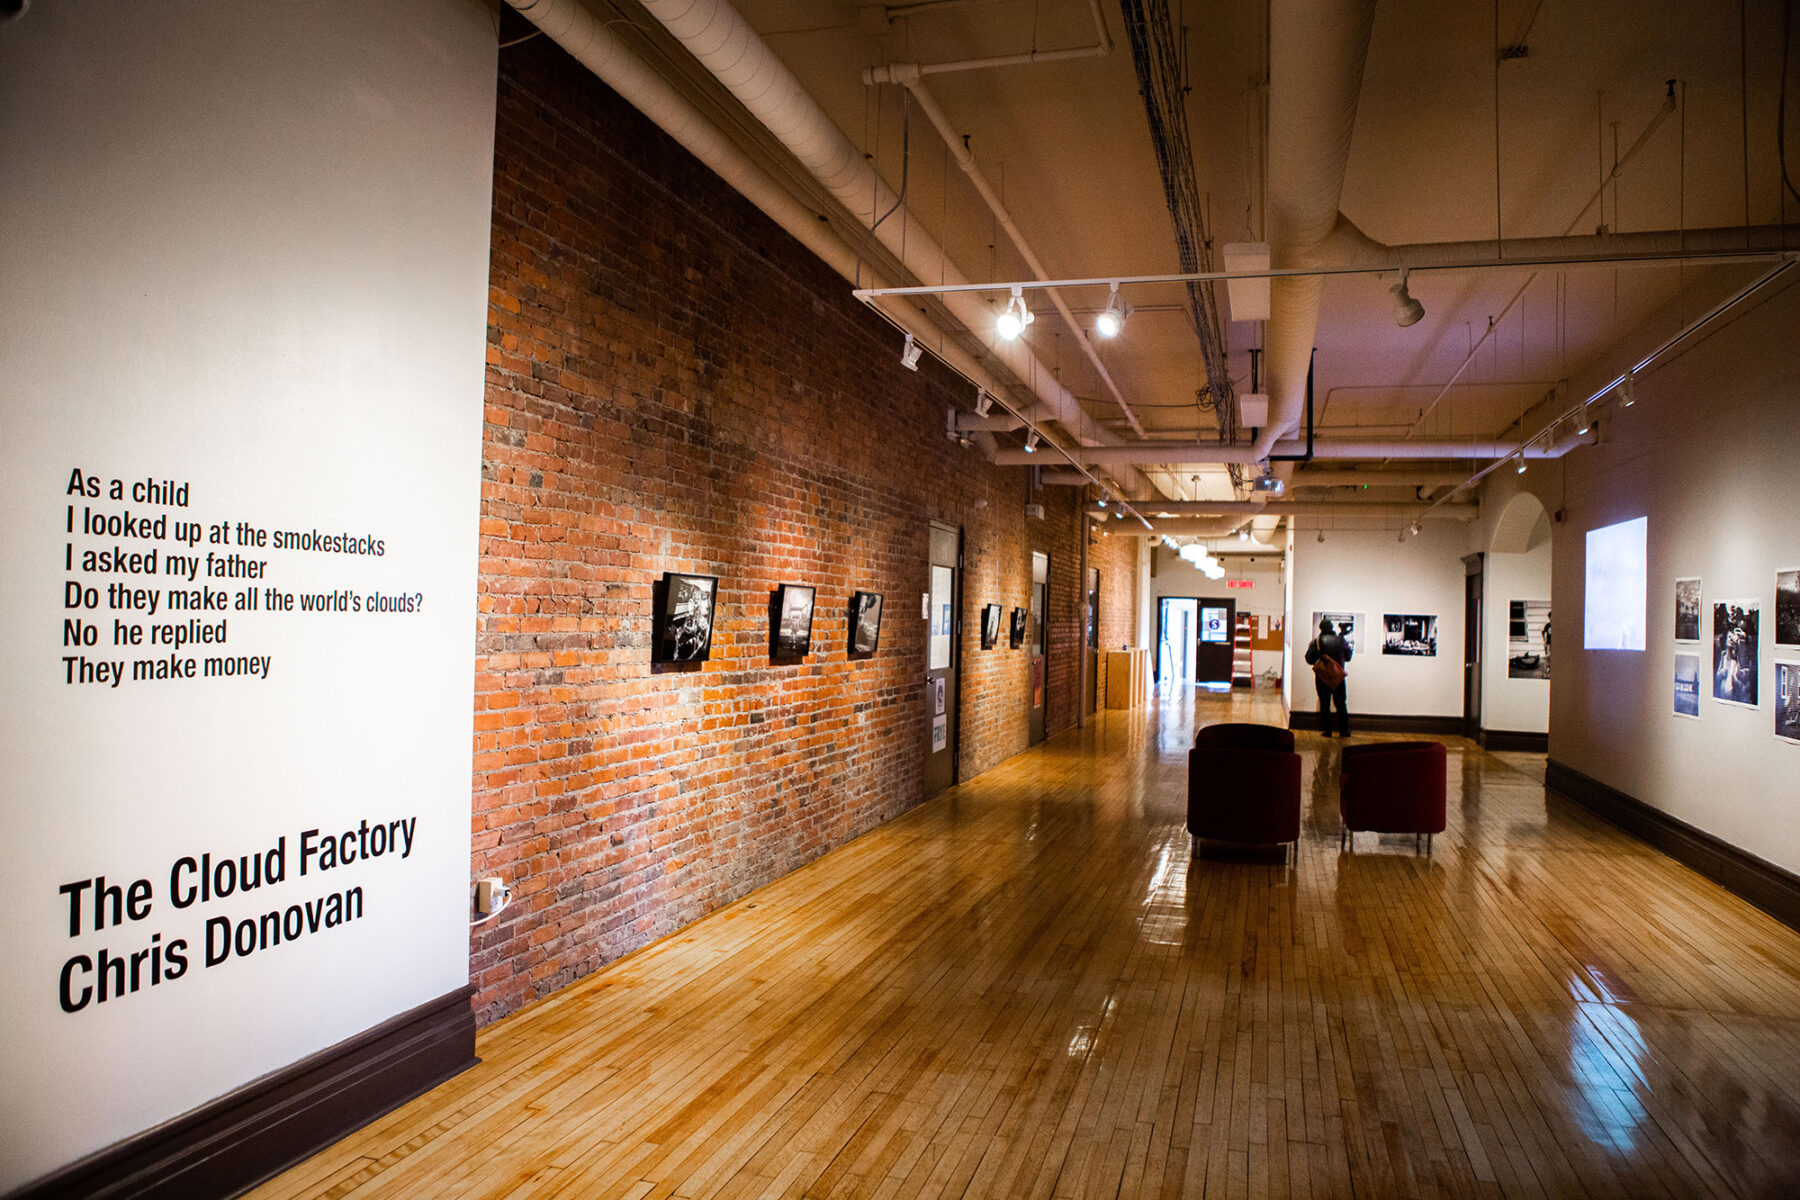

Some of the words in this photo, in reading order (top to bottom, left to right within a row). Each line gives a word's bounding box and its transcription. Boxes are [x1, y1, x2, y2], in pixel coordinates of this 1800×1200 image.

[66, 467, 101, 498] As
[109, 479, 123, 501] a
[132, 477, 189, 508] child
[66, 505, 74, 533] I
[84, 506, 167, 540] looked
[175, 521, 202, 548] up
[209, 521, 230, 545] at
[236, 522, 267, 548] the
[273, 529, 385, 557] smokestacks
[65, 542, 73, 571] I
[82, 546, 158, 575] asked
[166, 555, 200, 582] my
[206, 551, 267, 579] father
[64, 580, 99, 610] Do
[107, 582, 161, 616] they
[168, 585, 228, 611] make
[234, 587, 258, 611] all
[264, 587, 294, 612] the
[366, 591, 423, 613] clouds?
[63, 618, 98, 647] No
[114, 618, 143, 647] he
[151, 618, 227, 650] replied
[61, 656, 125, 689] They
[133, 653, 197, 681] make
[204, 656, 271, 680] money
[59, 875, 153, 938] The
[170, 836, 286, 909] Cloud
[300, 816, 417, 877] Factory
[59, 932, 188, 1014] Chris
[205, 886, 363, 969] Donovan
